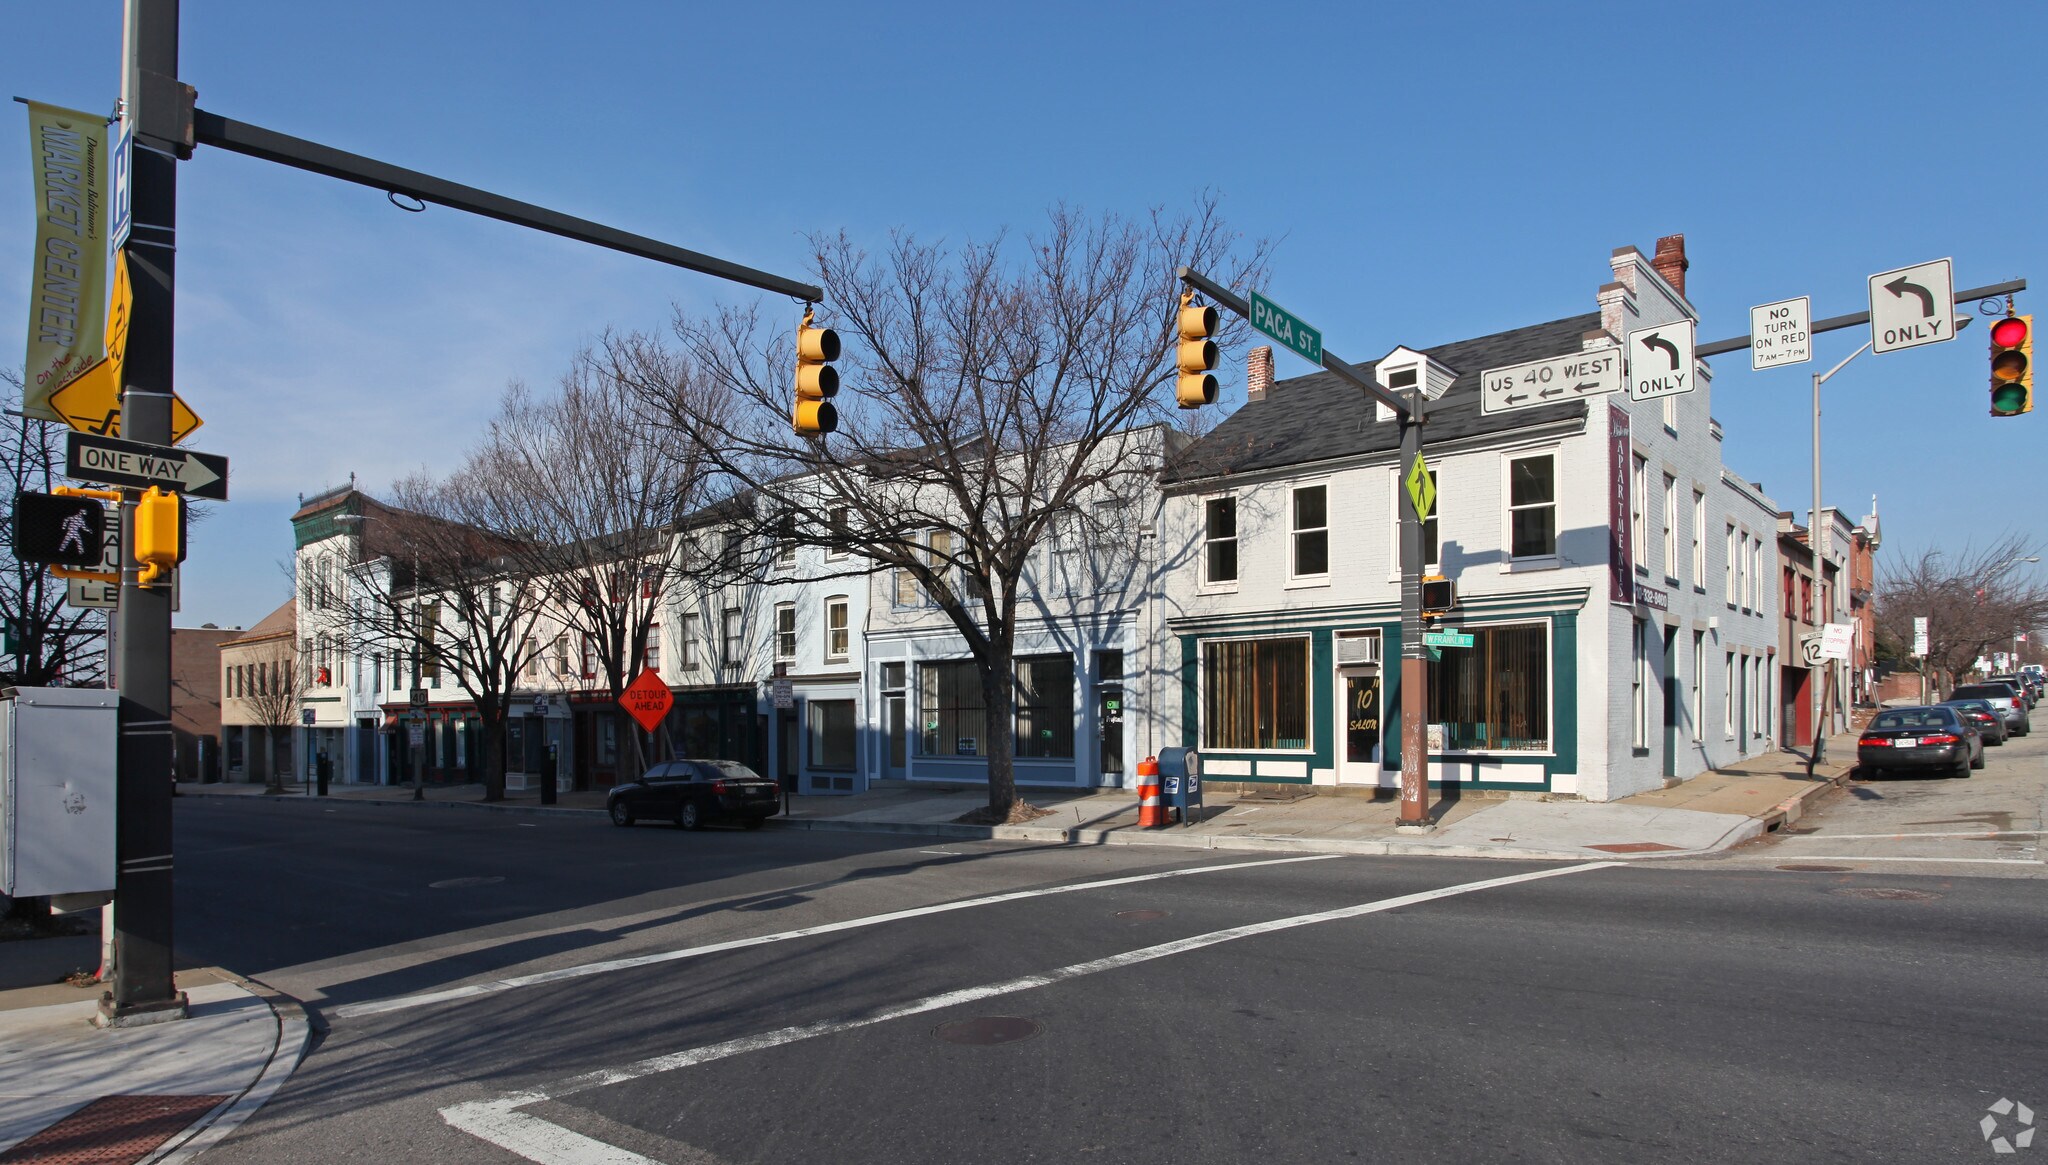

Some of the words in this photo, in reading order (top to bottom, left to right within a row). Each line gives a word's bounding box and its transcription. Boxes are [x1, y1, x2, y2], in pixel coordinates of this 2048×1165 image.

[87, 136, 98, 189] Downtown
[41, 125, 82, 236] MARKET
[115, 142, 129, 225] H
[87, 190, 98, 240] Baltimore's
[39, 237, 81, 348] CENTER
[1254, 300, 1294, 345] PACA
[1298, 332, 1318, 357] ST.
[1764, 320, 1797, 334] TURN
[1769, 307, 1790, 320] NO
[1755, 338, 1773, 350] ON
[1781, 331, 1806, 344] RED
[1884, 320, 1942, 345] ONLY
[36, 370, 53, 385] on
[52, 353, 72, 371] the
[1490, 374, 1513, 392] US
[1524, 366, 1553, 385] 40
[1564, 358, 1613, 379] WEST
[1638, 373, 1687, 395] ONLY
[86, 449, 131, 472] ONE
[139, 458, 184, 479] WAY
[1616, 440, 1625, 598] APARTMENTS
[412, 693, 425, 703] 40
[630, 690, 667, 699] DETOUR
[634, 701, 664, 711] AHEAD
[1349, 719, 1377, 730] SALON
